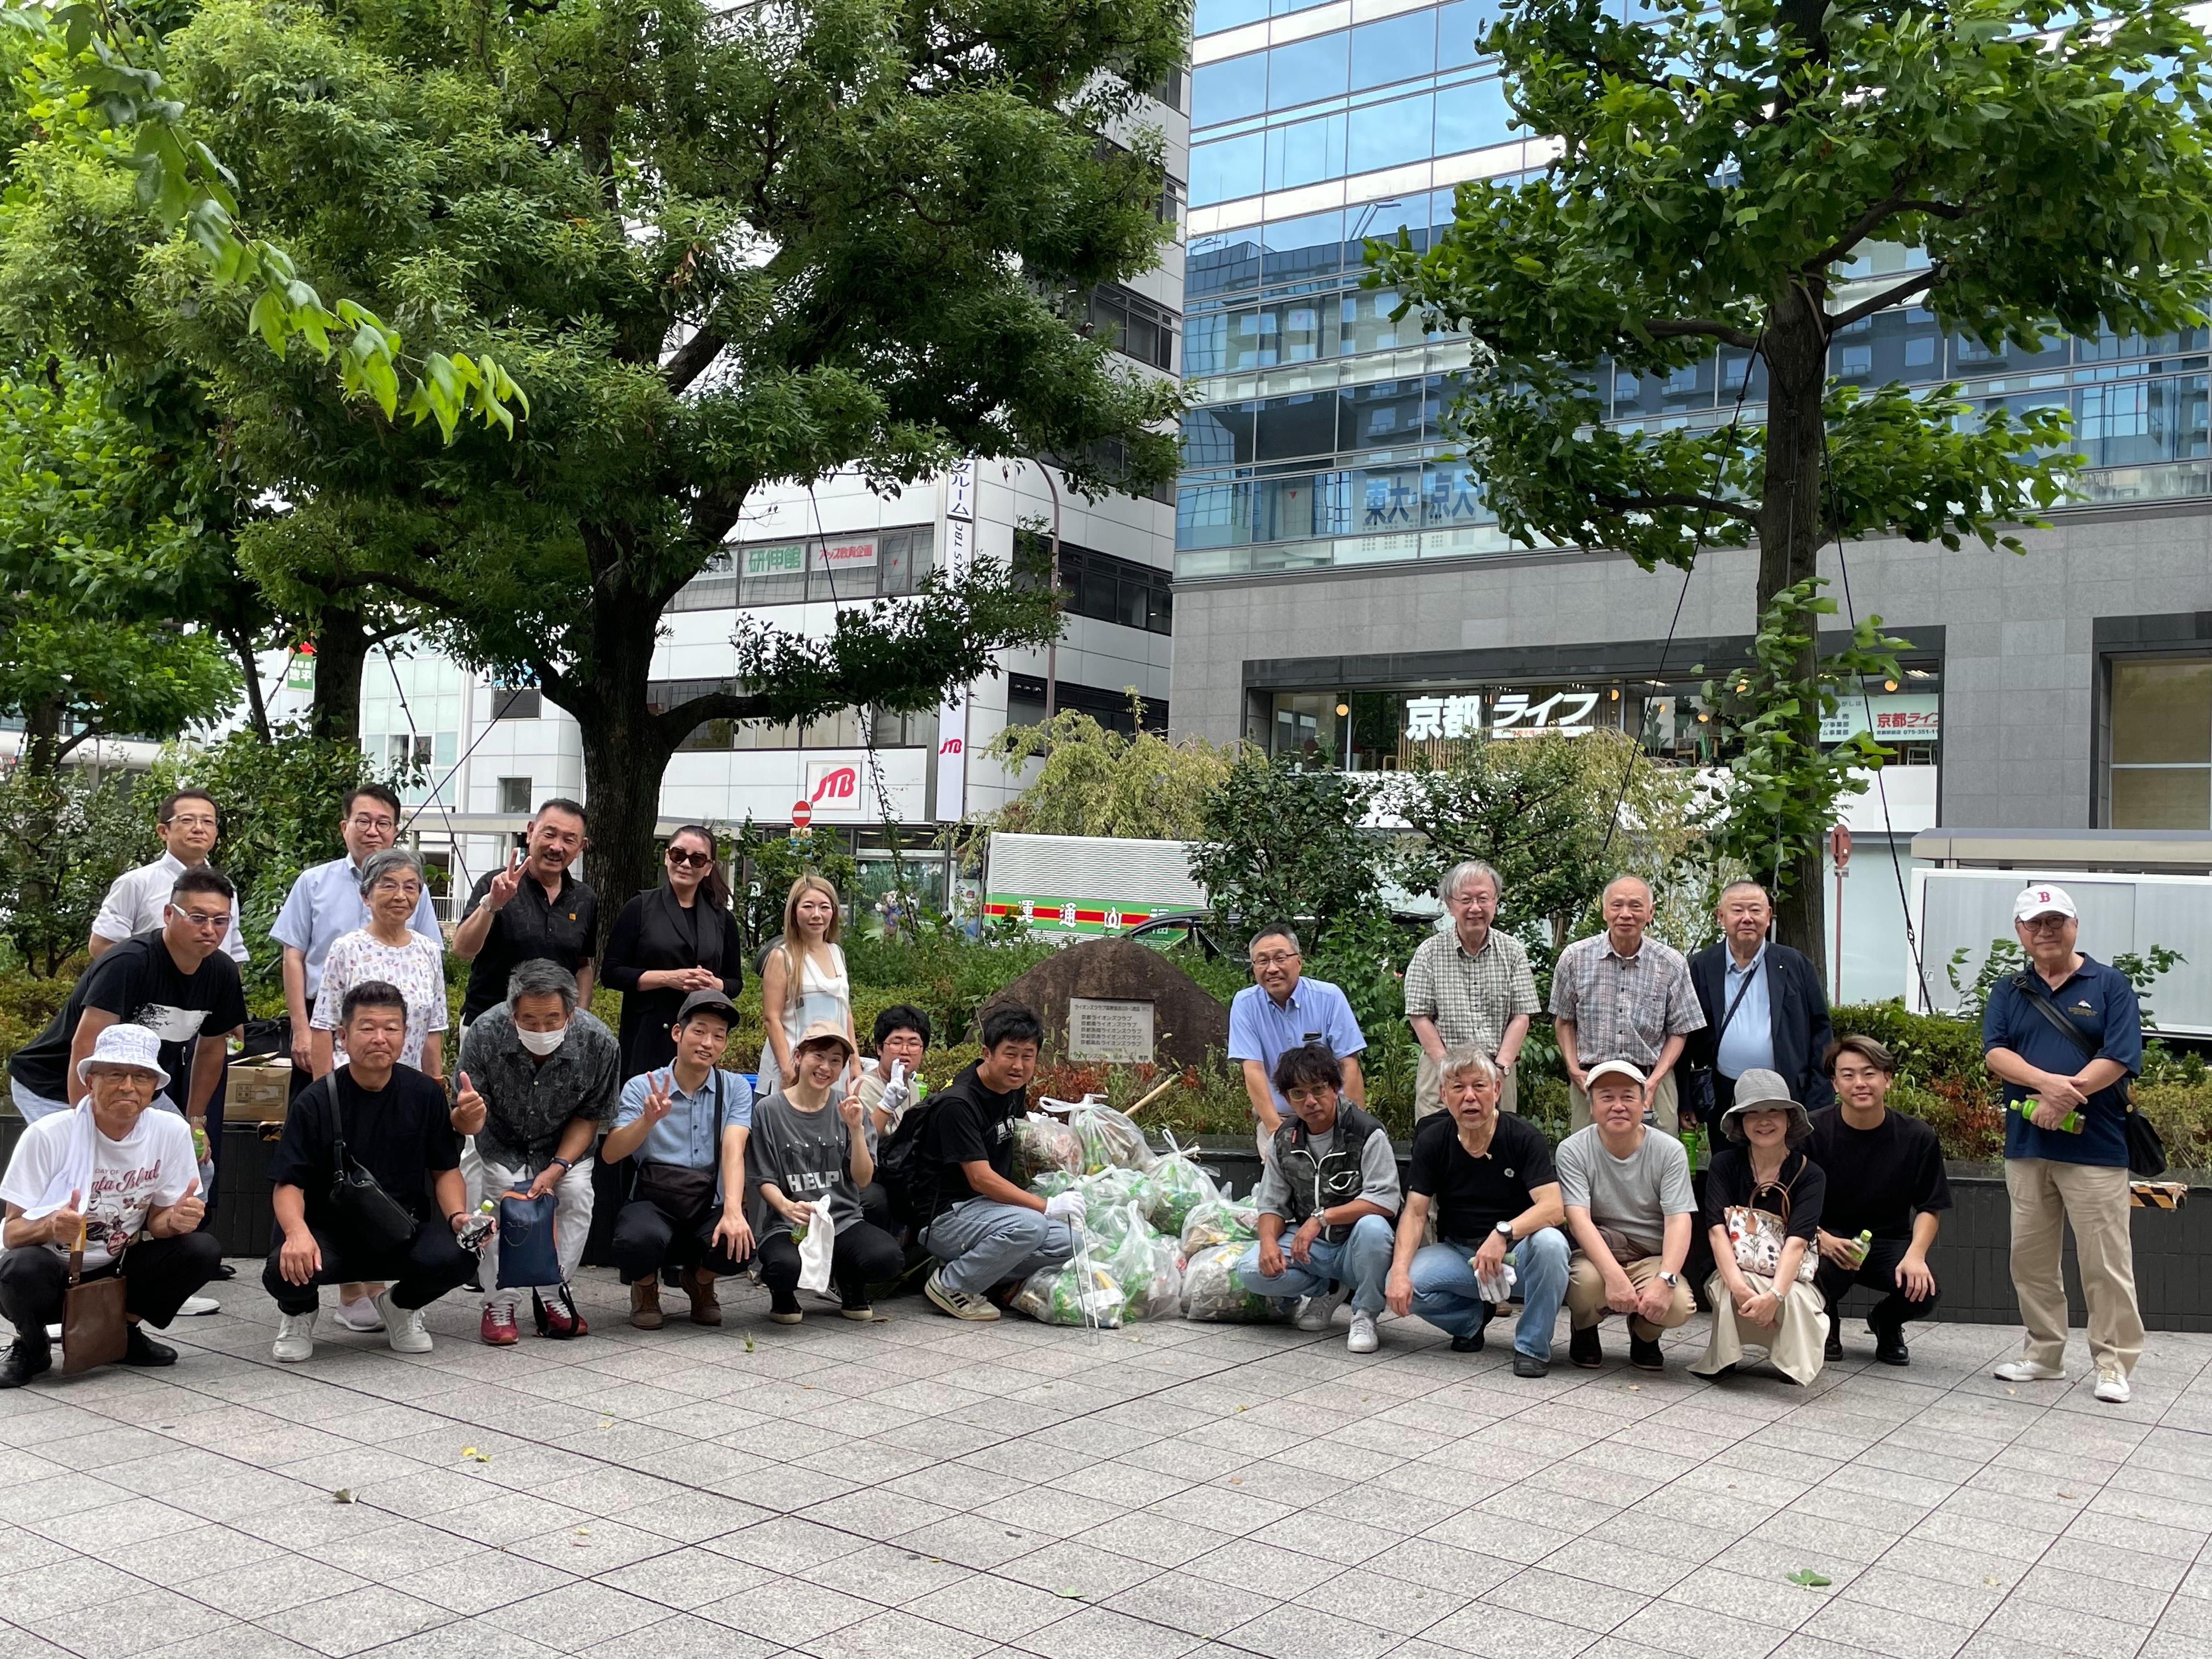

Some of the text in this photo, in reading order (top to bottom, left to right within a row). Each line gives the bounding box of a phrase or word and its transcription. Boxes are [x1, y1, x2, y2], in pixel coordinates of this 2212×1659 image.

[954, 522, 963, 548] TBC
[748, 546, 802, 573] 研伸館
[1405, 692, 1599, 741] 京都ライフ
[939, 738, 962, 754] JTB
[811, 768, 856, 803] JTB
[2037, 891, 2051, 903] B
[116, 1159, 161, 1193] Islnd
[786, 1170, 839, 1192] HELP
